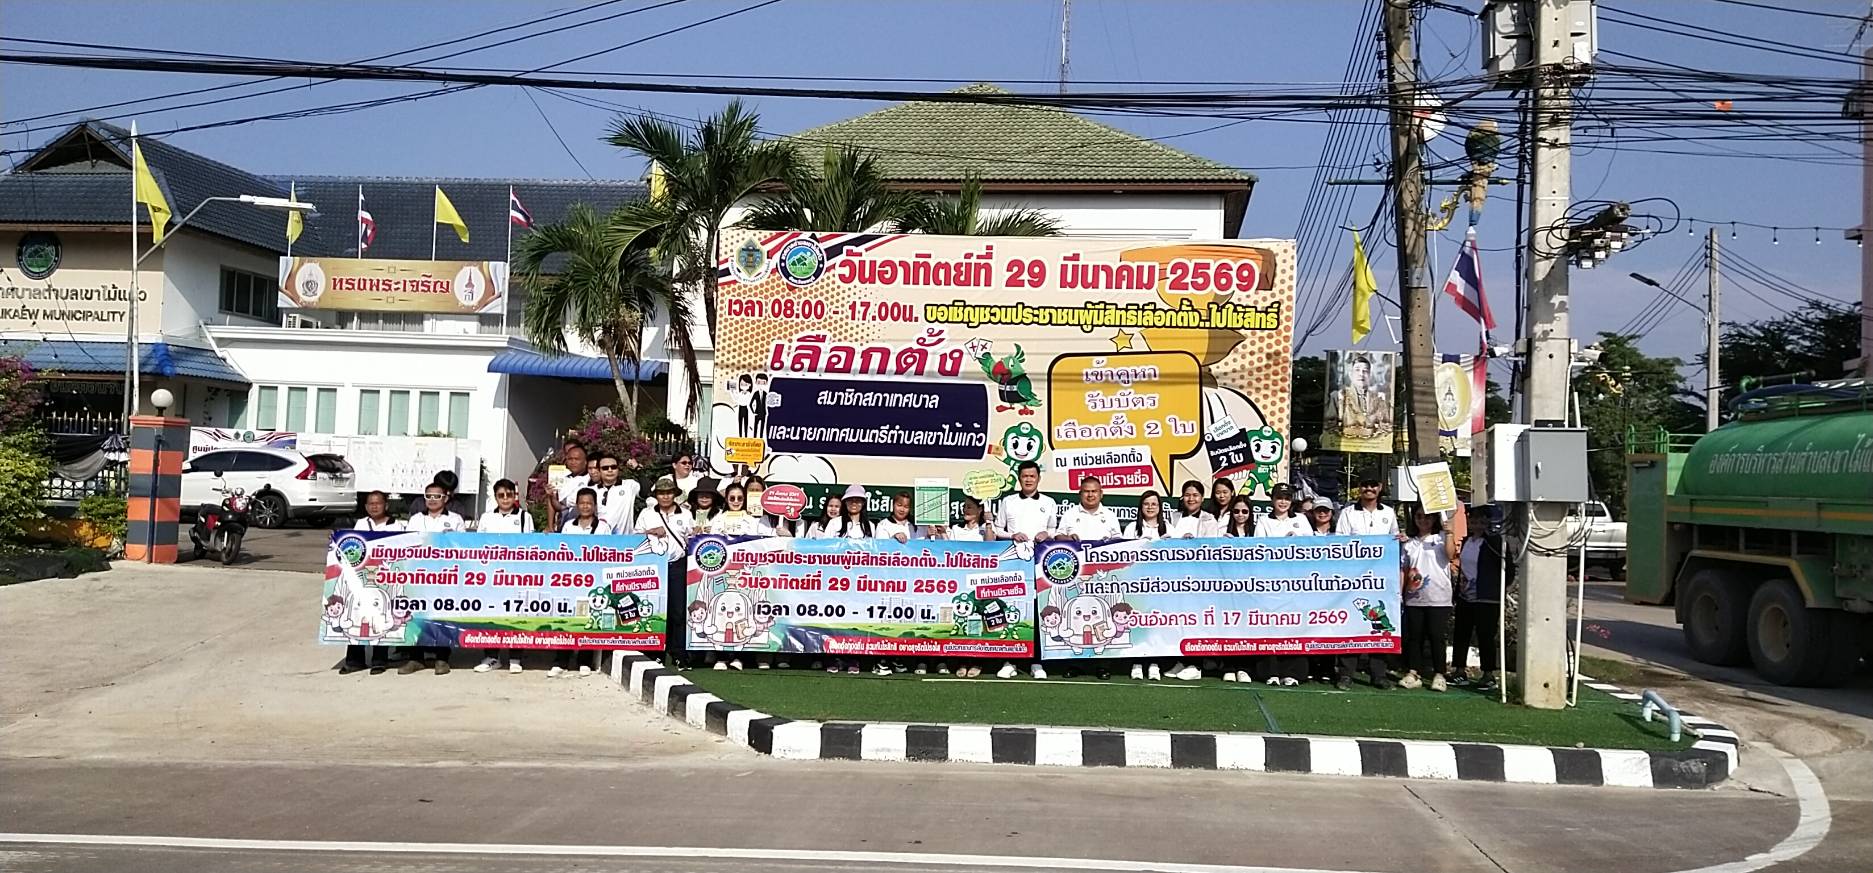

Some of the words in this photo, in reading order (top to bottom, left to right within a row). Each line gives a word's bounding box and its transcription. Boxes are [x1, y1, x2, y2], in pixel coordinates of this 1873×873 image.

[838, 245, 994, 287] วันอาทิตย์ที่
[1005, 259, 1046, 288] 29
[1060, 253, 1156, 290] มีนาคม
[1168, 262, 1256, 292] 2569
[331, 274, 451, 294] ทรงพระเจริญ
[0, 308, 39, 320] IKAEW
[43, 310, 126, 322] MUNICIPALITY
[727, 299, 763, 318] เวลา
[770, 299, 825, 319] 08.00
[850, 302, 919, 322] 17.00น.
[770, 327, 964, 376] เลือกตั้ง
[1084, 359, 1158, 385] เข้าคูหา
[816, 389, 940, 409] สมาชิกสภาเทศบาล
[1087, 391, 1158, 410] รับบัตร
[768, 422, 986, 447] และนายกเทศมนตรีตำบลเขาไม้แก้ว
[1056, 415, 1134, 439] เลือกตั้ง
[1145, 422, 1160, 435] 2
[1168, 417, 1195, 434] ใบ
[1055, 457, 1067, 468] ณ
[1073, 448, 1143, 466] หน่วยเลือกตั้ง
[1219, 455, 1229, 467] 2
[1229, 452, 1244, 464] ใบ
[1083, 541, 1384, 562] โครงการรณรงค์เสริมสร้างประชาธิปไตย
[376, 565, 459, 584] วันอาทิตย์ที่
[464, 572, 487, 586] 29
[493, 569, 544, 586] มีนาคม
[550, 573, 594, 587] 2569
[738, 571, 822, 590] วันอาทิตย์ที่
[828, 577, 850, 591] 29
[857, 574, 907, 592] มีนาคม
[913, 579, 958, 593] 2569
[1085, 571, 1385, 594] และการมีส่วนร่วมของประชาชนในท้องถิ่น
[395, 599, 427, 611] เวลา
[433, 598, 481, 611] 08.00
[503, 600, 551, 612] 17.00
[557, 602, 572, 613] น.
[756, 604, 790, 616] เวลา
[796, 604, 846, 617] 08.00
[866, 606, 914, 619] 17.00
[921, 608, 936, 620] น.
[1128, 608, 1197, 627] วันอังคาร
[1204, 606, 1215, 625] ที่
[1224, 612, 1241, 625] 17
[1249, 609, 1301, 626] มีนาคม
[1308, 611, 1348, 625] 2569
